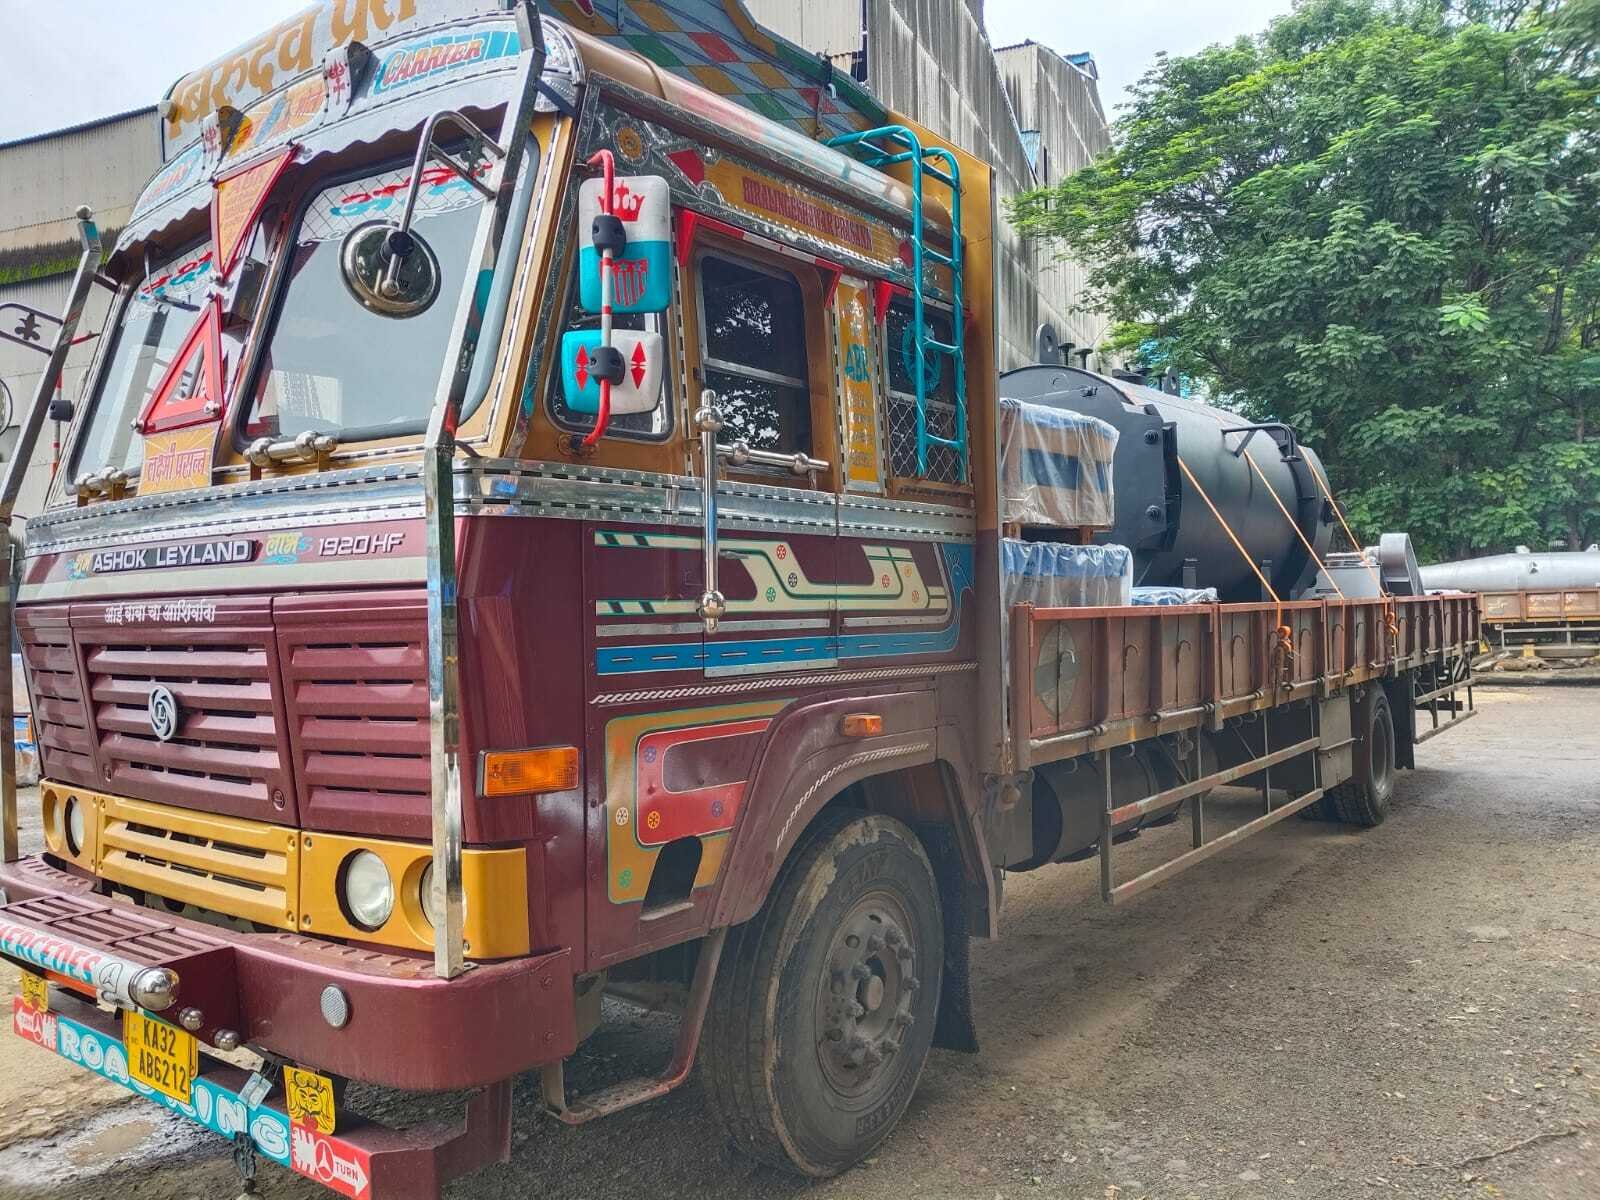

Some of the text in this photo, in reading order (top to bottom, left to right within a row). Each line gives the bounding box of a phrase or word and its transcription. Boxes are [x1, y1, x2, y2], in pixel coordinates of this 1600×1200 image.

[382, 39, 482, 87] CARRIER
[93, 540, 250, 572] ASHOK LEYLAND
[0, 924, 101, 984] ERCEDES
[143, 1018, 176, 1058] KA32
[139, 1048, 187, 1096] AB6212
[335, 1161, 359, 1182] TURN
